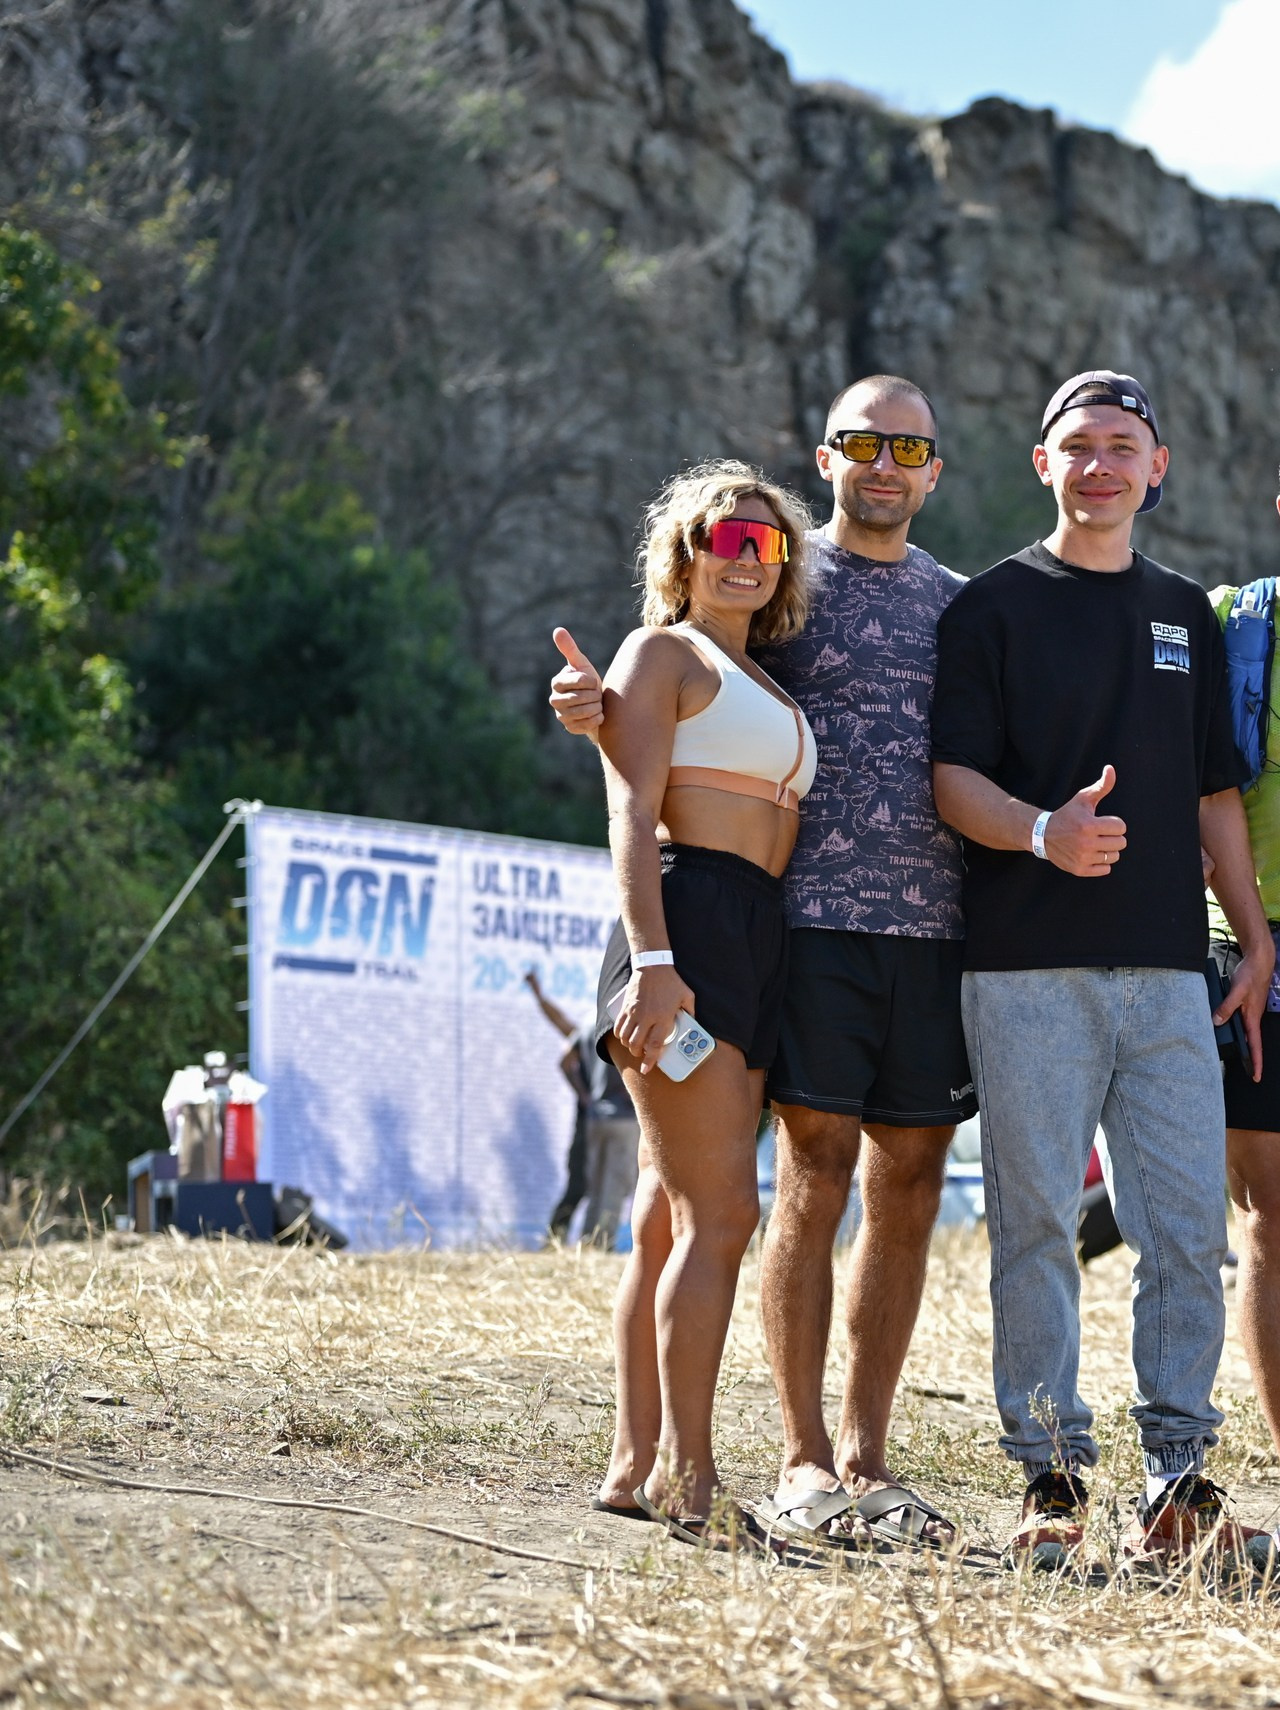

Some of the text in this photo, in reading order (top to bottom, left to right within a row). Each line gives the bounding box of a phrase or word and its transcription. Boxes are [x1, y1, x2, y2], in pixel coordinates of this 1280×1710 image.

[1153, 625, 1187, 637] ЯДРО
[885, 668, 934, 685] TRAVELLING
[860, 704, 891, 713] NATURE
[889, 855, 935, 869] TRAVELLING
[473, 861, 562, 899] ULTRA
[802, 883, 829, 892] comfort
[859, 890, 892, 900] NATURE
[363, 961, 419, 982] TRAIL
